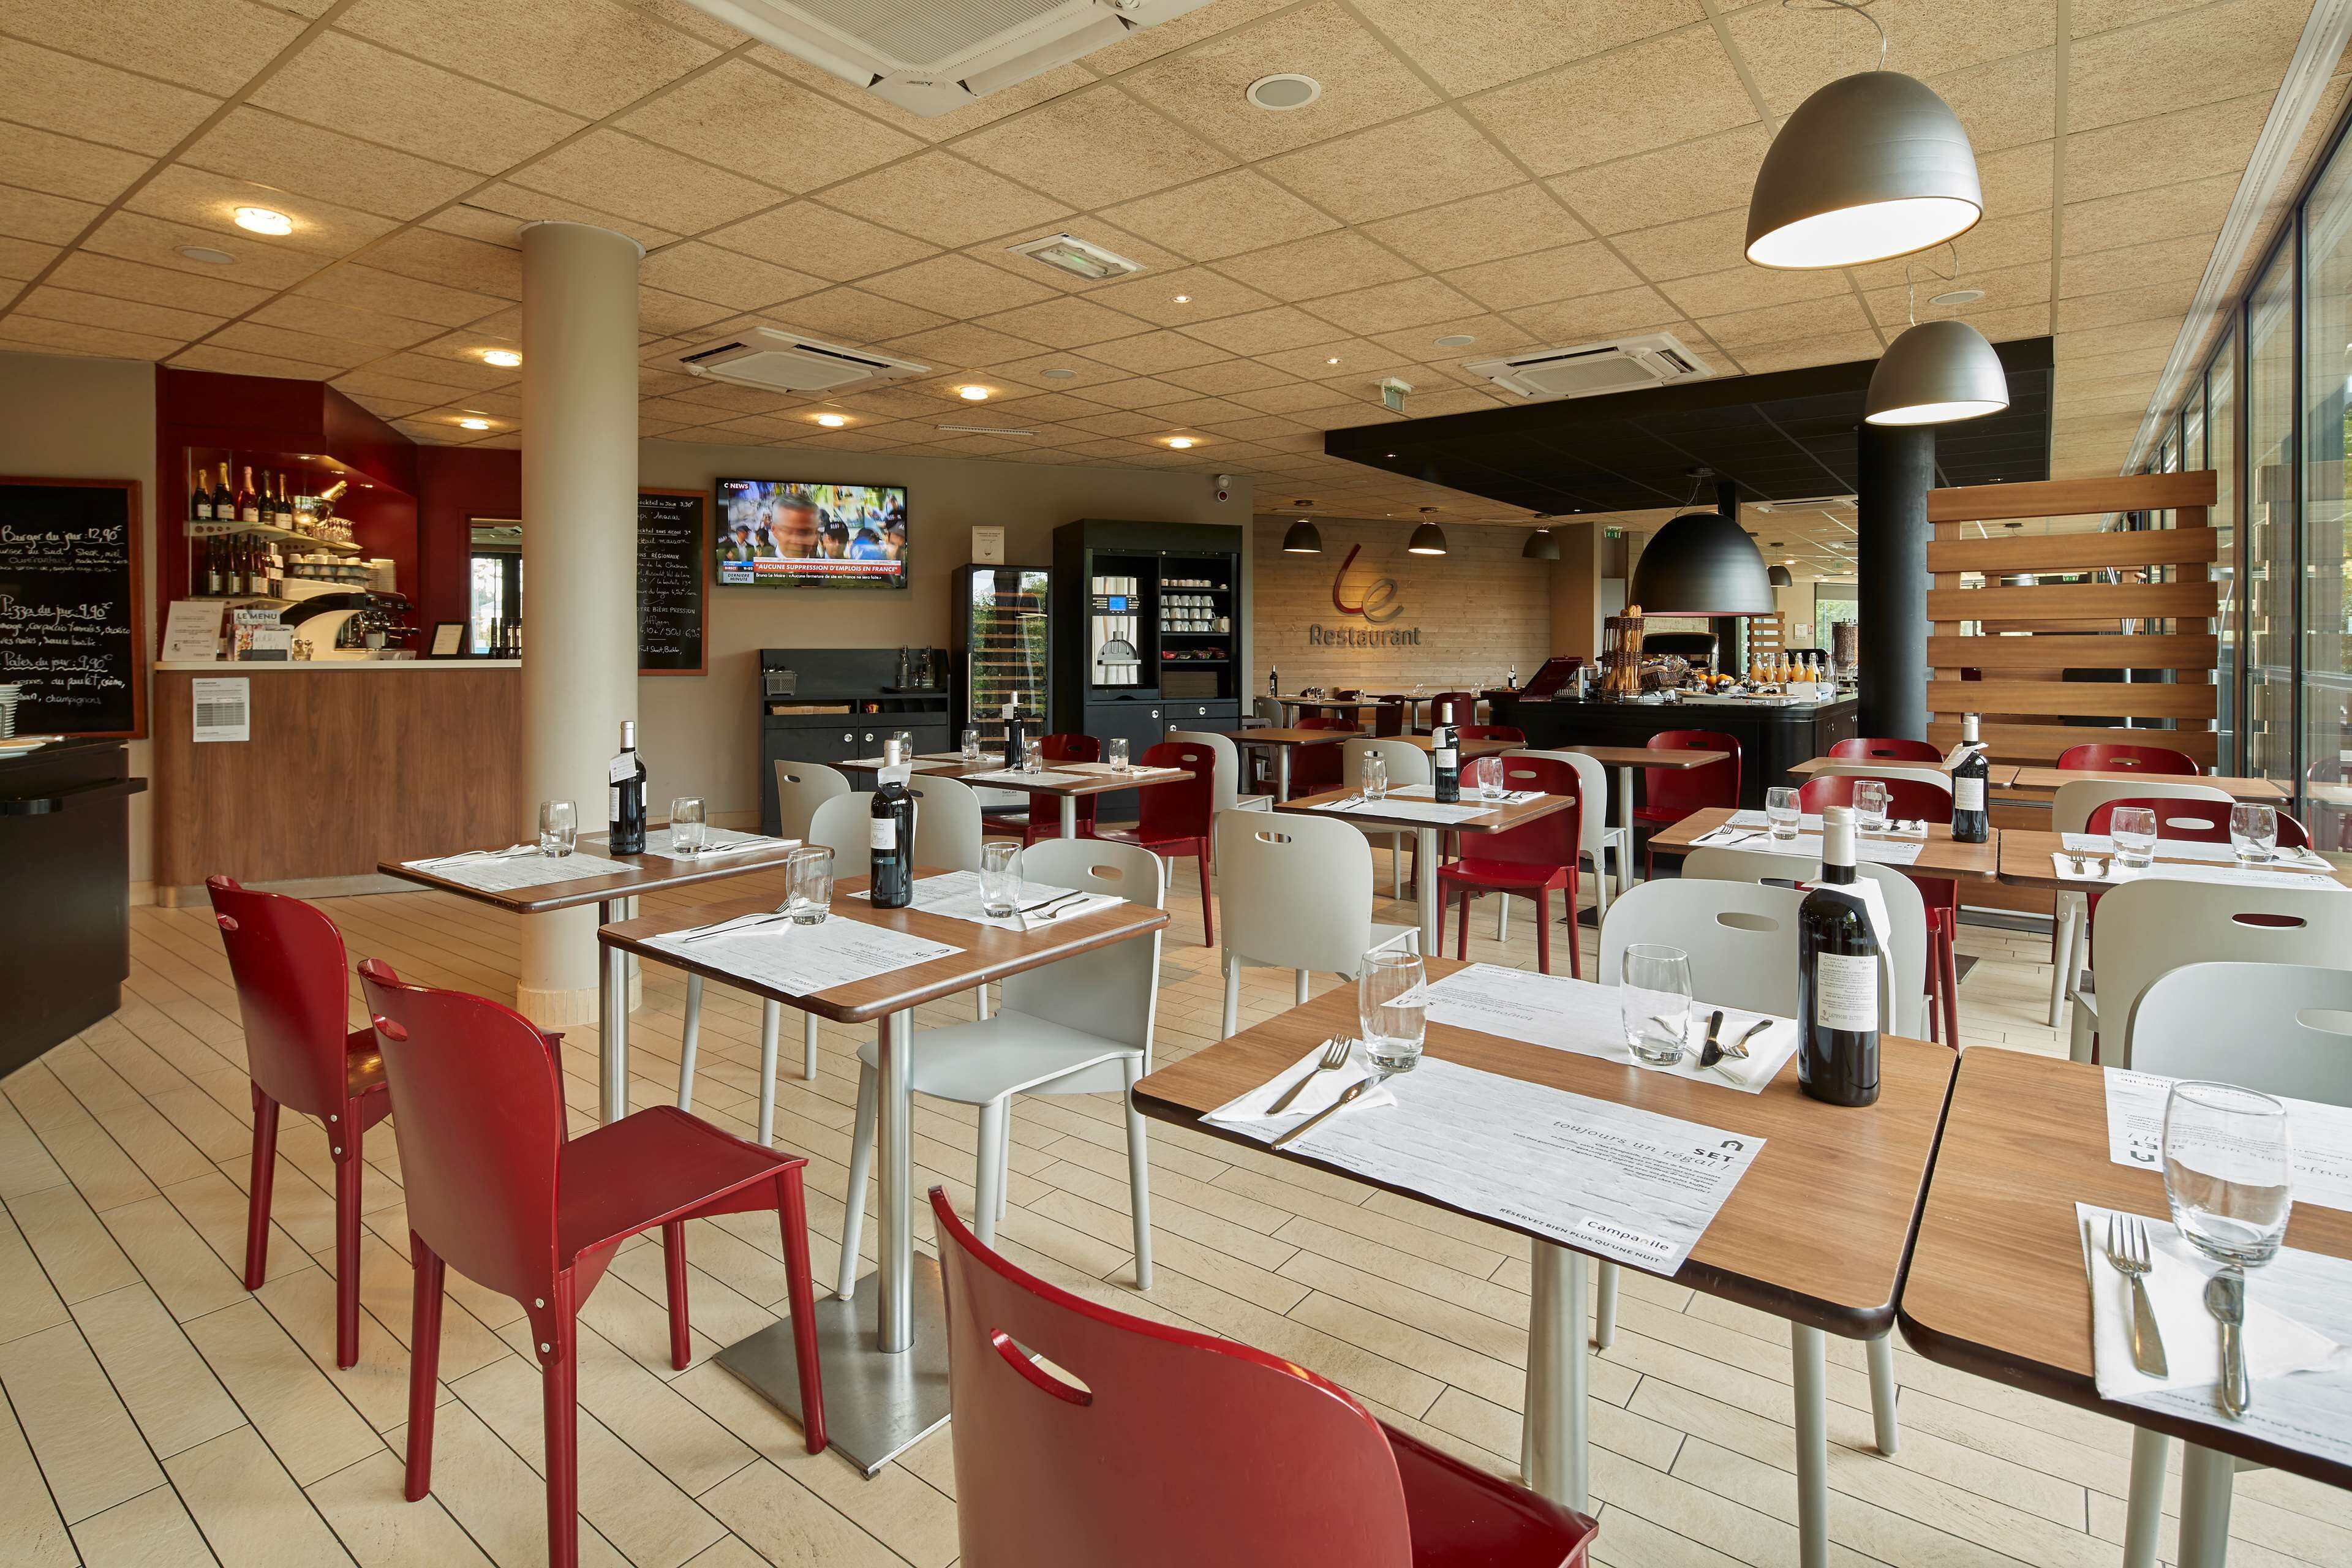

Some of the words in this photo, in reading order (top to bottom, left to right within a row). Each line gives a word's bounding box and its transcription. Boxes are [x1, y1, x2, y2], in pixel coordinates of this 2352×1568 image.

[2, 525, 43, 549] Burger
[45, 532, 60, 541] du
[1310, 624, 1422, 647] Restaurant
[35, 657, 50, 666] du
[1553, 1121, 1627, 1144] toujours
[1633, 1142, 1656, 1152] un
[1663, 1150, 1716, 1168] régal
[1693, 1148, 1735, 1162] SET
[1545, 1222, 1569, 1234] BIEN
[1569, 1231, 1593, 1242] PLUS
[1594, 1238, 1633, 1254] QU'UNE
[1634, 1252, 1661, 1263] NUIT
[1587, 1220, 1670, 1251] Campanile
